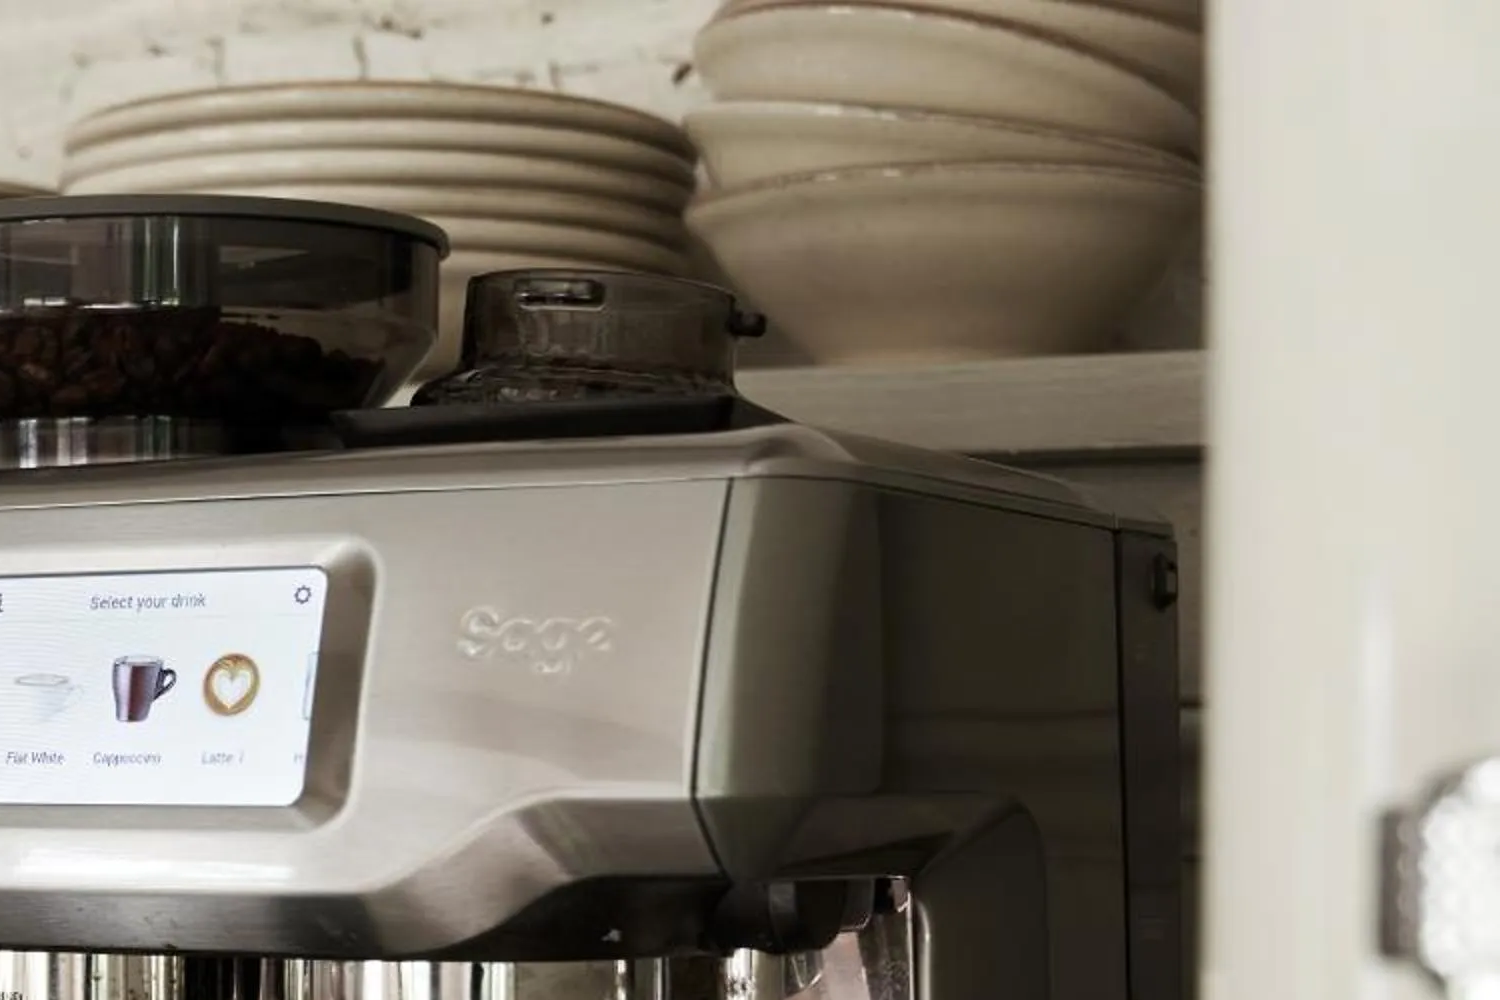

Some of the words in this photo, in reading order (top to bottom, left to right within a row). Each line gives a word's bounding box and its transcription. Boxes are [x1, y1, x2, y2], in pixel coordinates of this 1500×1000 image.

[90, 595, 133, 611] Select
[136, 595, 168, 613] your
[171, 592, 206, 608] drink
[31, 751, 65, 765] White
[201, 751, 233, 765] Latte
